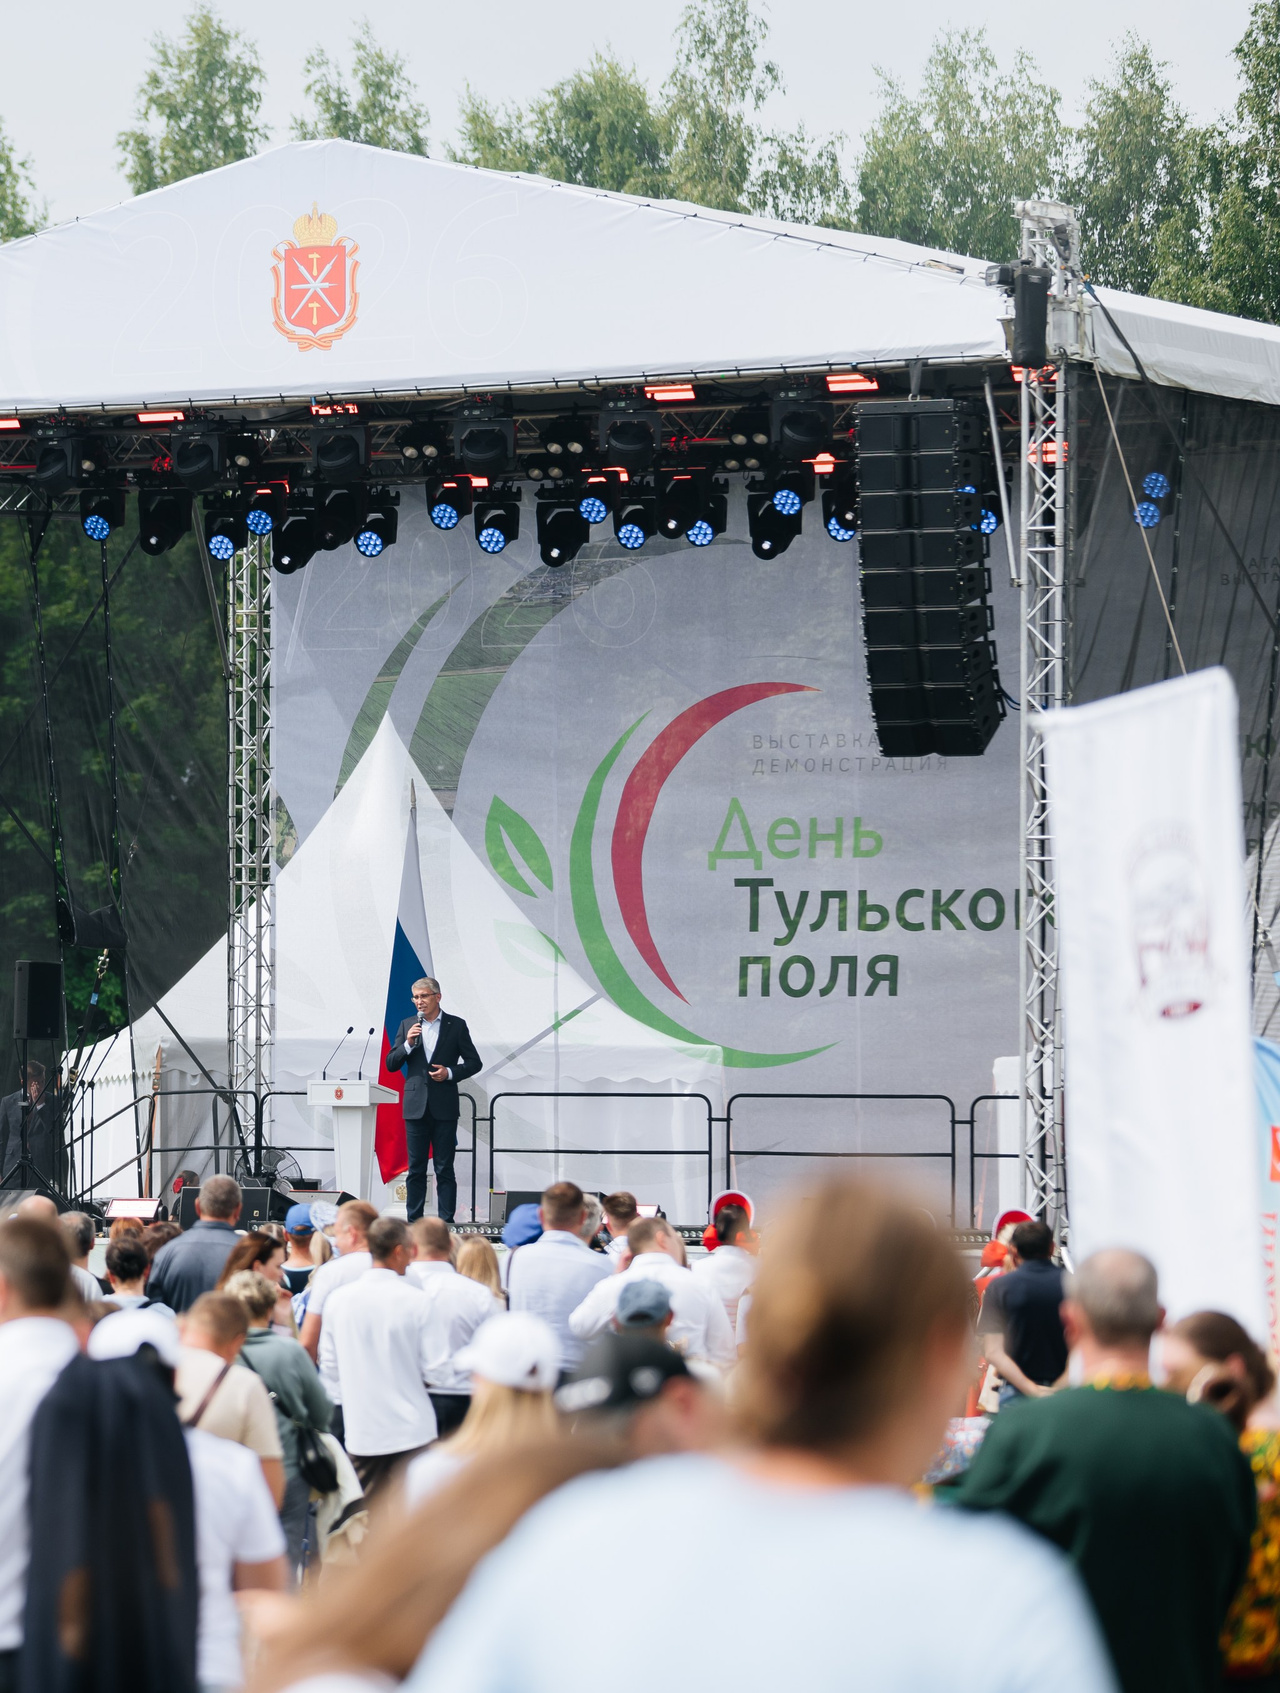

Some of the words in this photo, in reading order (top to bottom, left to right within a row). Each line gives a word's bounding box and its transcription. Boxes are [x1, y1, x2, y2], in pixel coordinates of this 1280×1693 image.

[109, 191, 529, 377] 2026
[752, 733, 881, 750] ВЫСТАВКА
[752, 756, 948, 776] ДЕМОНСТРАЦИЯ
[708, 797, 884, 871] День
[738, 953, 899, 998] поля
